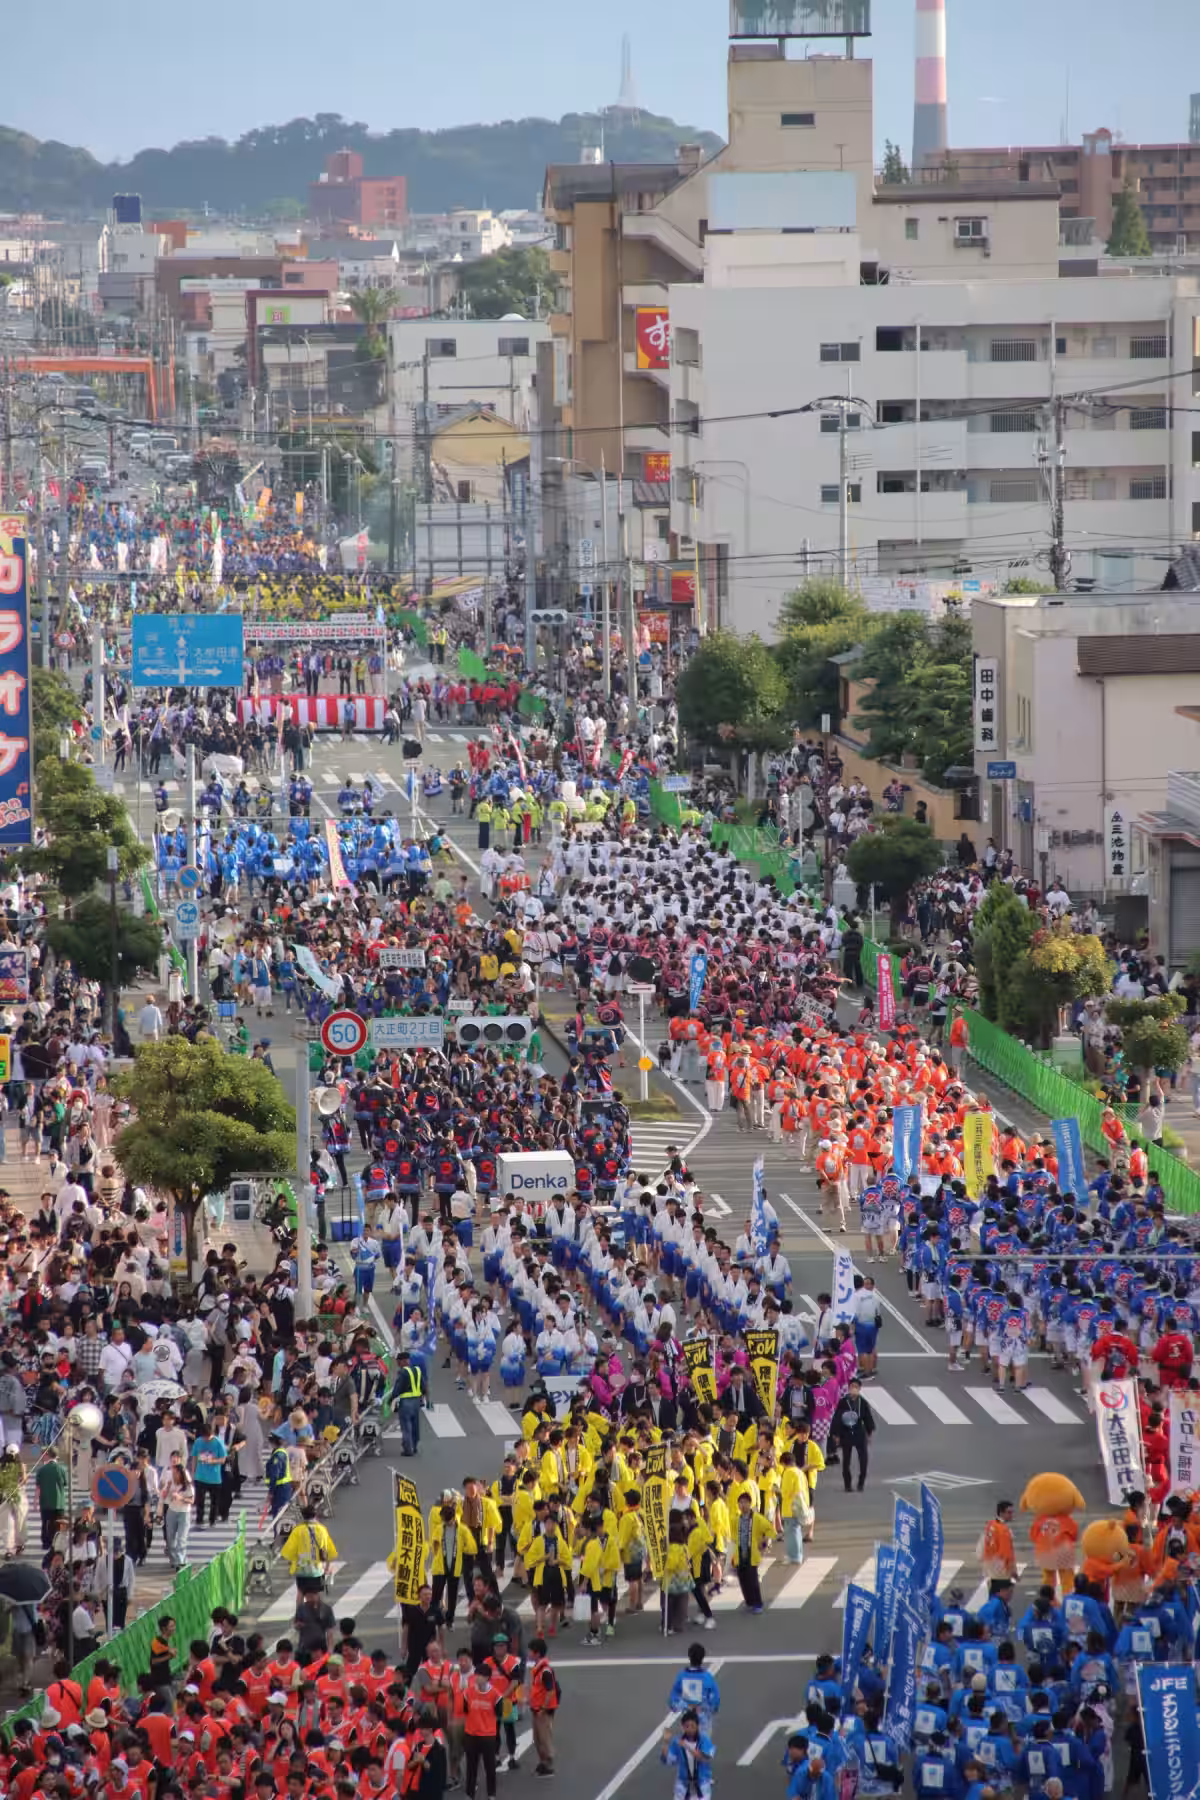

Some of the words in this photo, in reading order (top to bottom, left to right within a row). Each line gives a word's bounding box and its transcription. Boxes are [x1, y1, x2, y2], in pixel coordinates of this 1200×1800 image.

[980, 668, 993, 742] 田中歯科
[332, 1024, 357, 1043] 50
[375, 1022, 440, 1035] 大正町2丁目
[511, 1172, 567, 1189] Denka
[880, 1558, 895, 1569] JF
[1150, 1677, 1188, 1690] JFE
